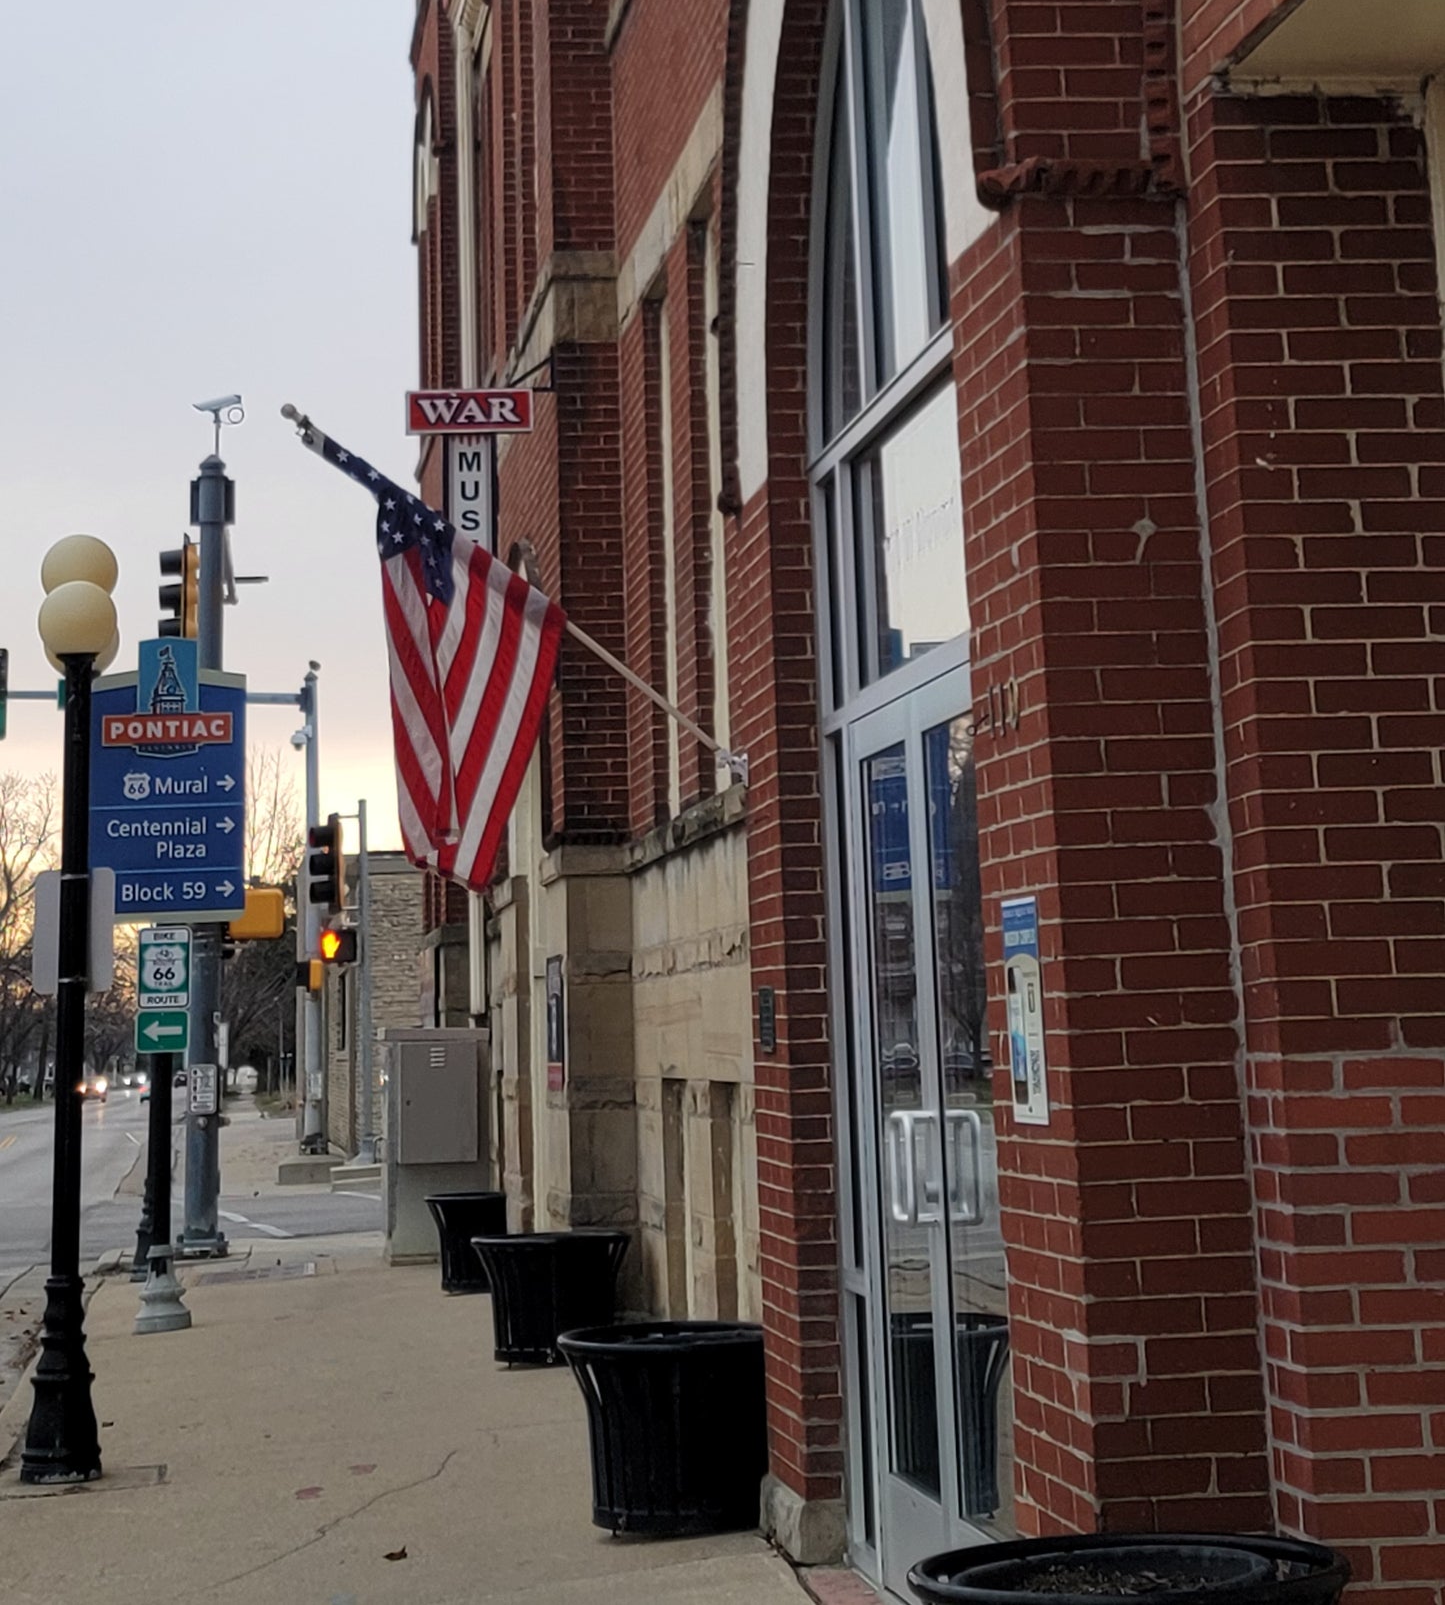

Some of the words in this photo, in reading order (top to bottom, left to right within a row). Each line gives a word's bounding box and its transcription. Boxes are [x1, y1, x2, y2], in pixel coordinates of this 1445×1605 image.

[417, 397, 521, 425] WAR
[458, 451, 482, 543] MUS
[110, 718, 225, 739] PONTIAC
[128, 783, 146, 795] 66
[155, 776, 208, 795] Mural
[107, 817, 207, 837] Centennial
[156, 841, 207, 859] Plaza
[121, 883, 174, 902] Block
[182, 882, 207, 900] 59
[153, 932, 176, 941] BIKE
[153, 967, 175, 981] 66
[147, 996, 180, 1005] ROUTE
